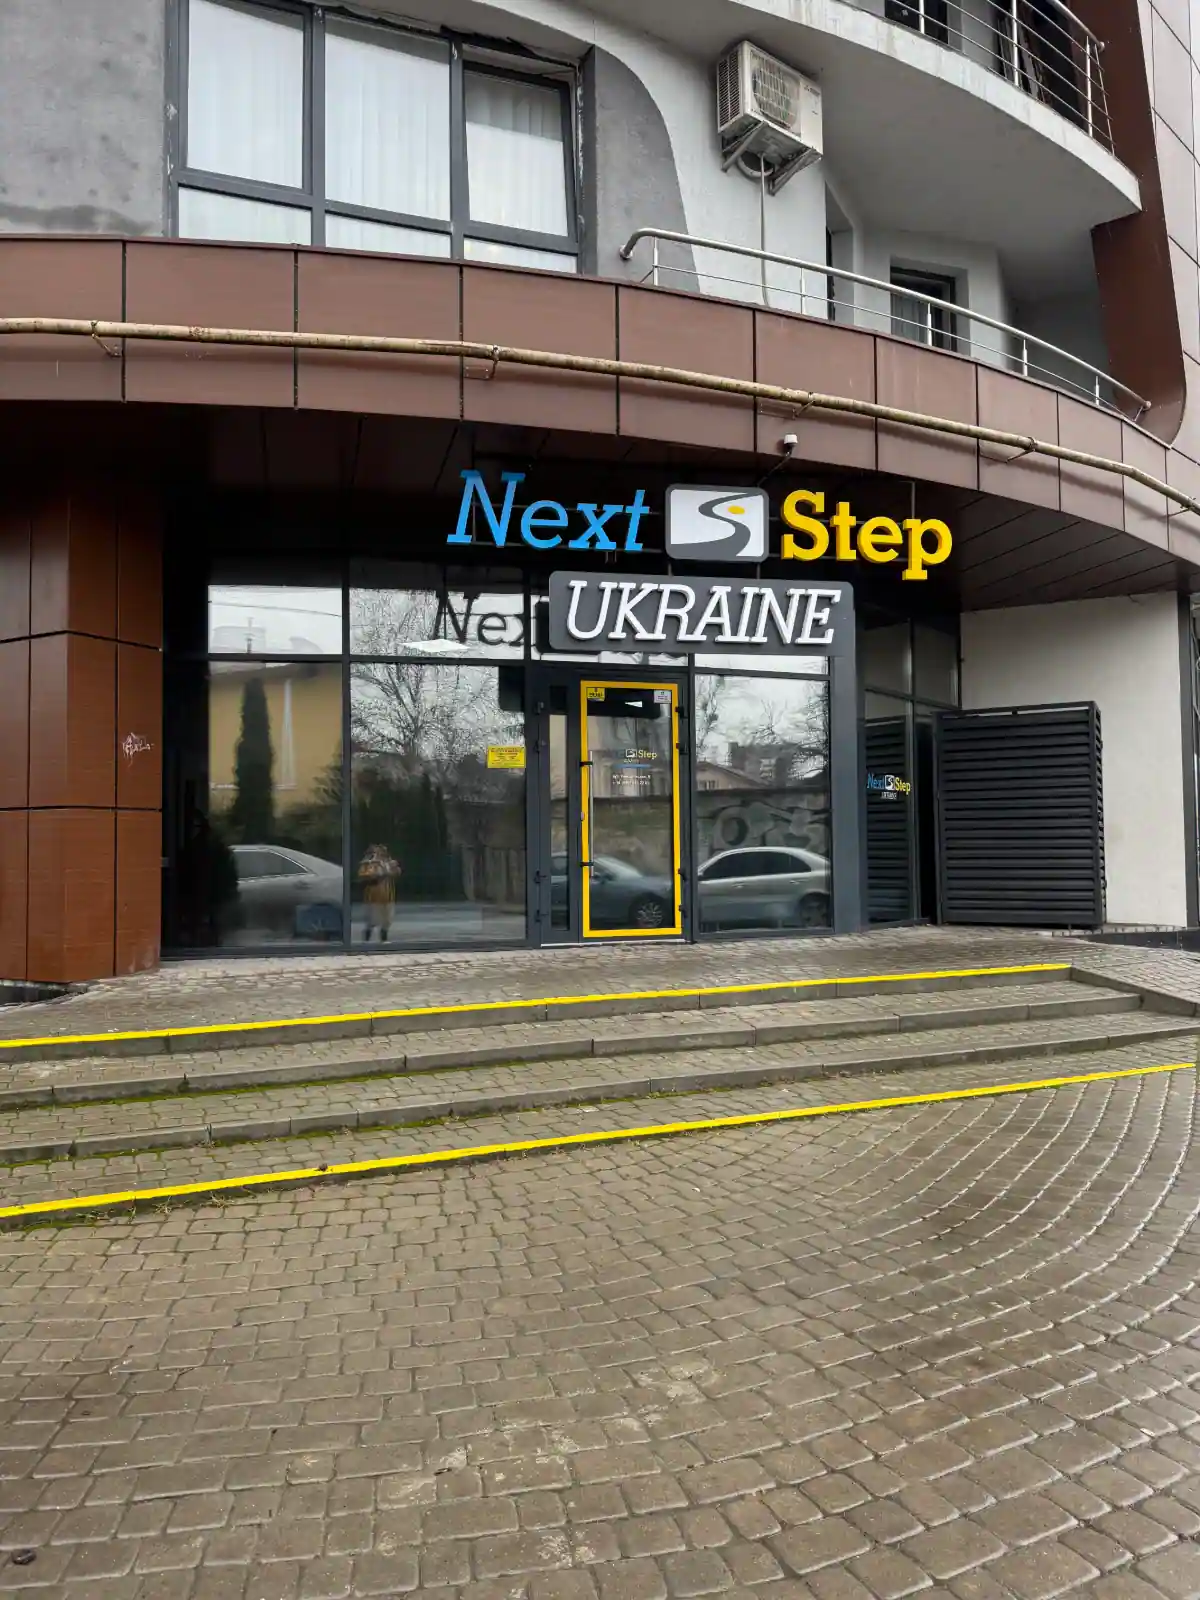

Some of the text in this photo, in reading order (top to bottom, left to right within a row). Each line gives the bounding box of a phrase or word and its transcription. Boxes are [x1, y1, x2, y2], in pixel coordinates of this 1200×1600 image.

[446, 469, 954, 581] Next Step
[566, 579, 842, 646] UKRAINE
[894, 776, 911, 796] Step
